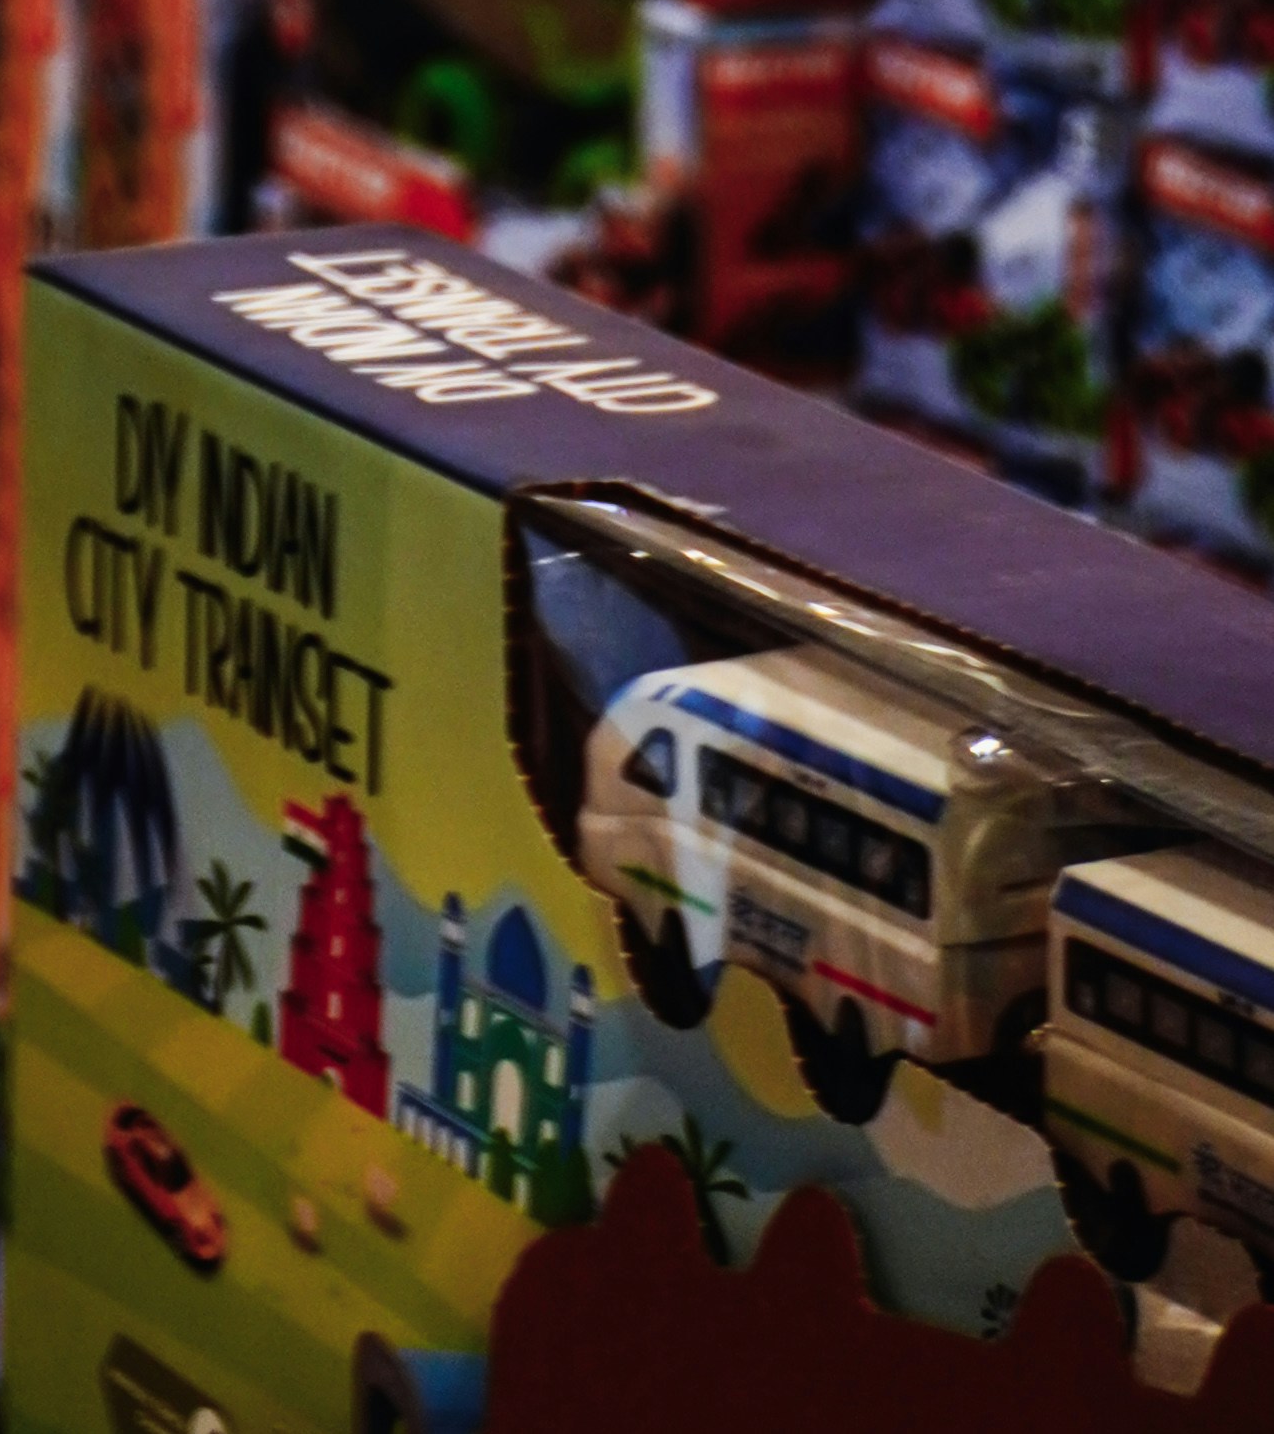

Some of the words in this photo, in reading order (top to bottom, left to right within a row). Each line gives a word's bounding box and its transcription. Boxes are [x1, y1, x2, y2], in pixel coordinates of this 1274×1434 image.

[504, 357, 718, 414] CITY
[115, 394, 191, 538] DIY
[199, 429, 338, 621] INDIAN
[65, 515, 165, 673] CITY
[176, 568, 394, 797] TRAINSET
